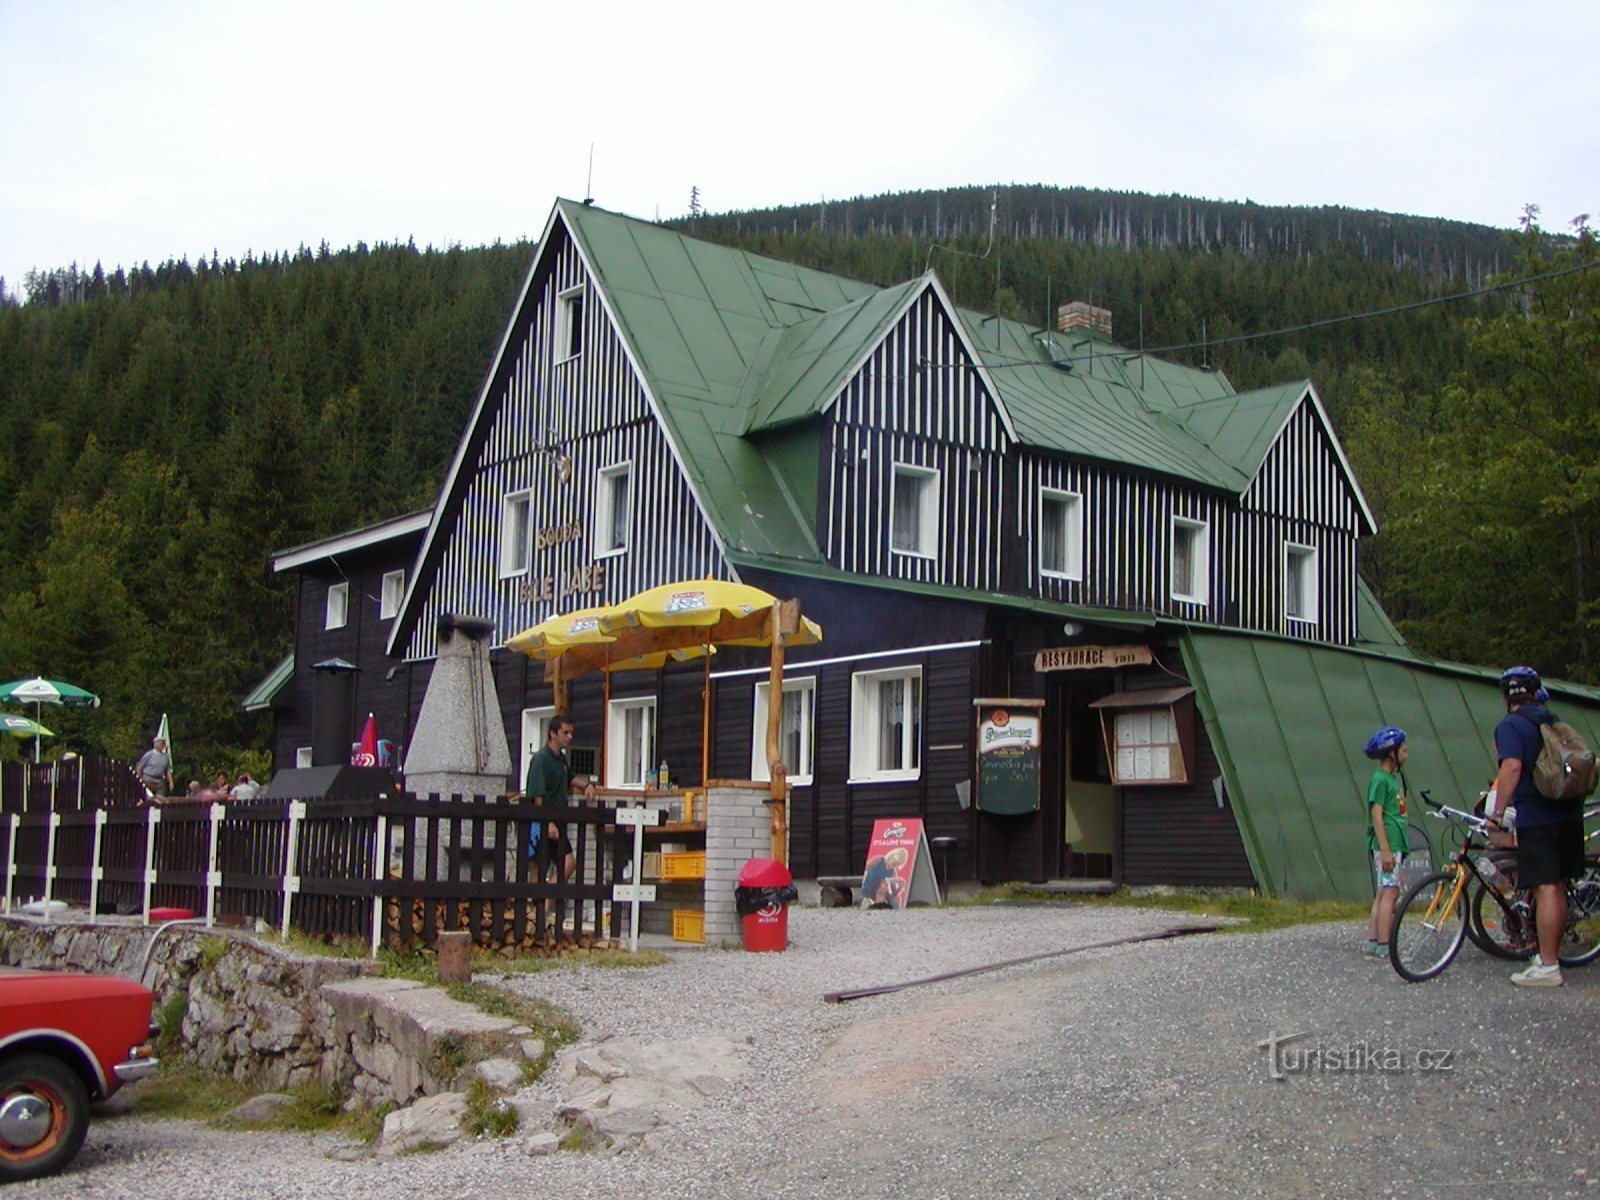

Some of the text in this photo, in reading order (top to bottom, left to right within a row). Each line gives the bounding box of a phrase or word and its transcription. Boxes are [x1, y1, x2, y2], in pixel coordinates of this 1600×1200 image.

[538, 521, 581, 549] BOUDA
[562, 565, 604, 596] LABE
[1042, 650, 1103, 667] RESTAURACE
